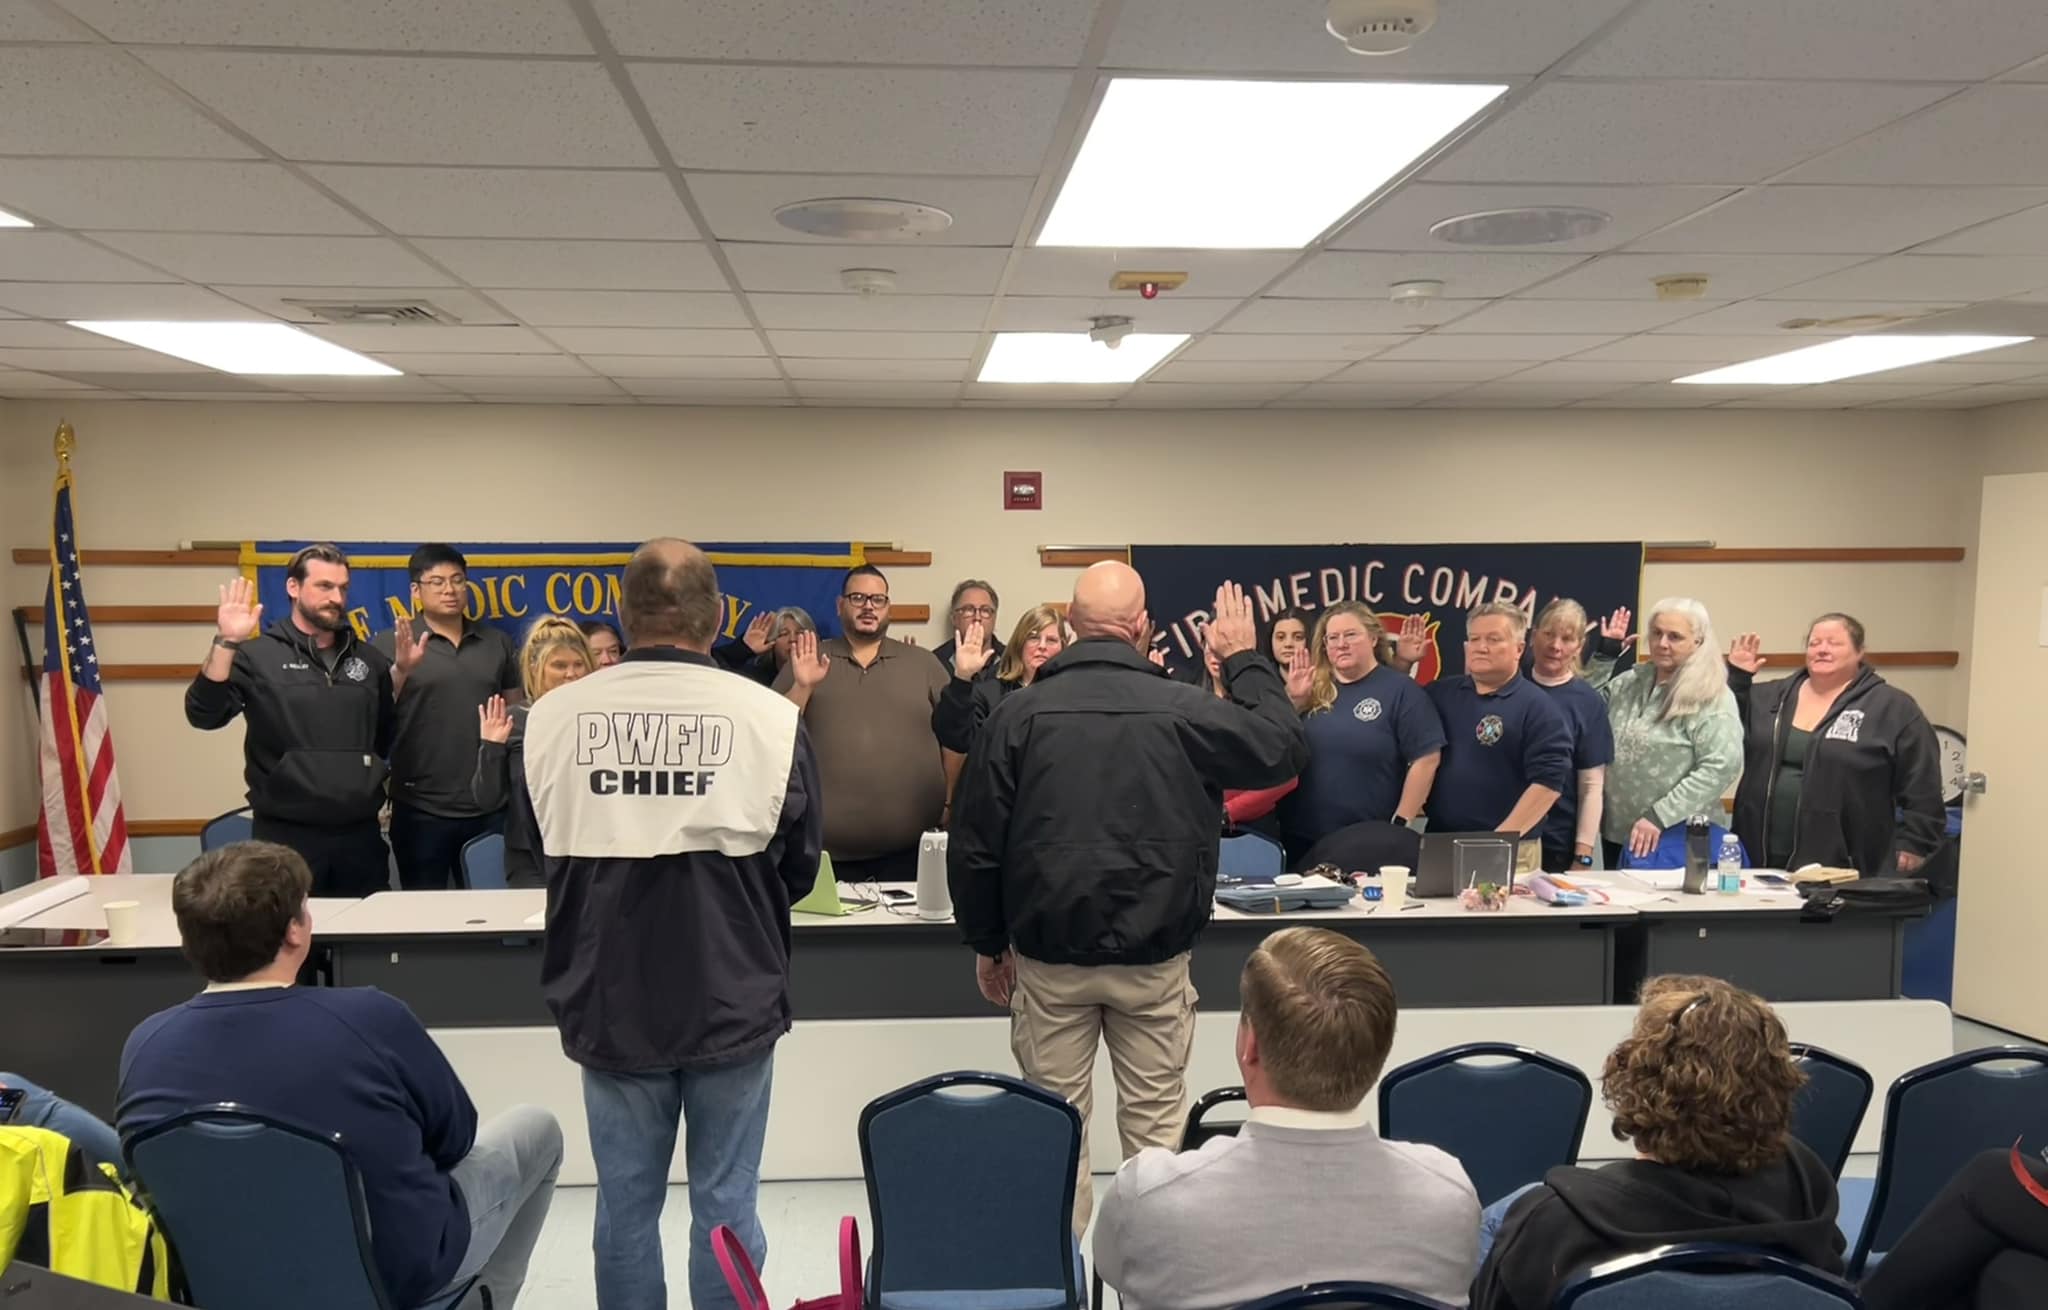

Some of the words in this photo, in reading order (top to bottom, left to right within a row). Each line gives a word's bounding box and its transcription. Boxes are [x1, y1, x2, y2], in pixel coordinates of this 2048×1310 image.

[385, 573, 529, 622] MDIC
[1253, 560, 1385, 623] MEDIC
[1403, 562, 1598, 632] COMPA
[576, 712, 734, 767] PWFD
[1951, 751, 1961, 761] 2
[589, 769, 715, 796] CHIEF
[1954, 763, 1964, 774] 3
